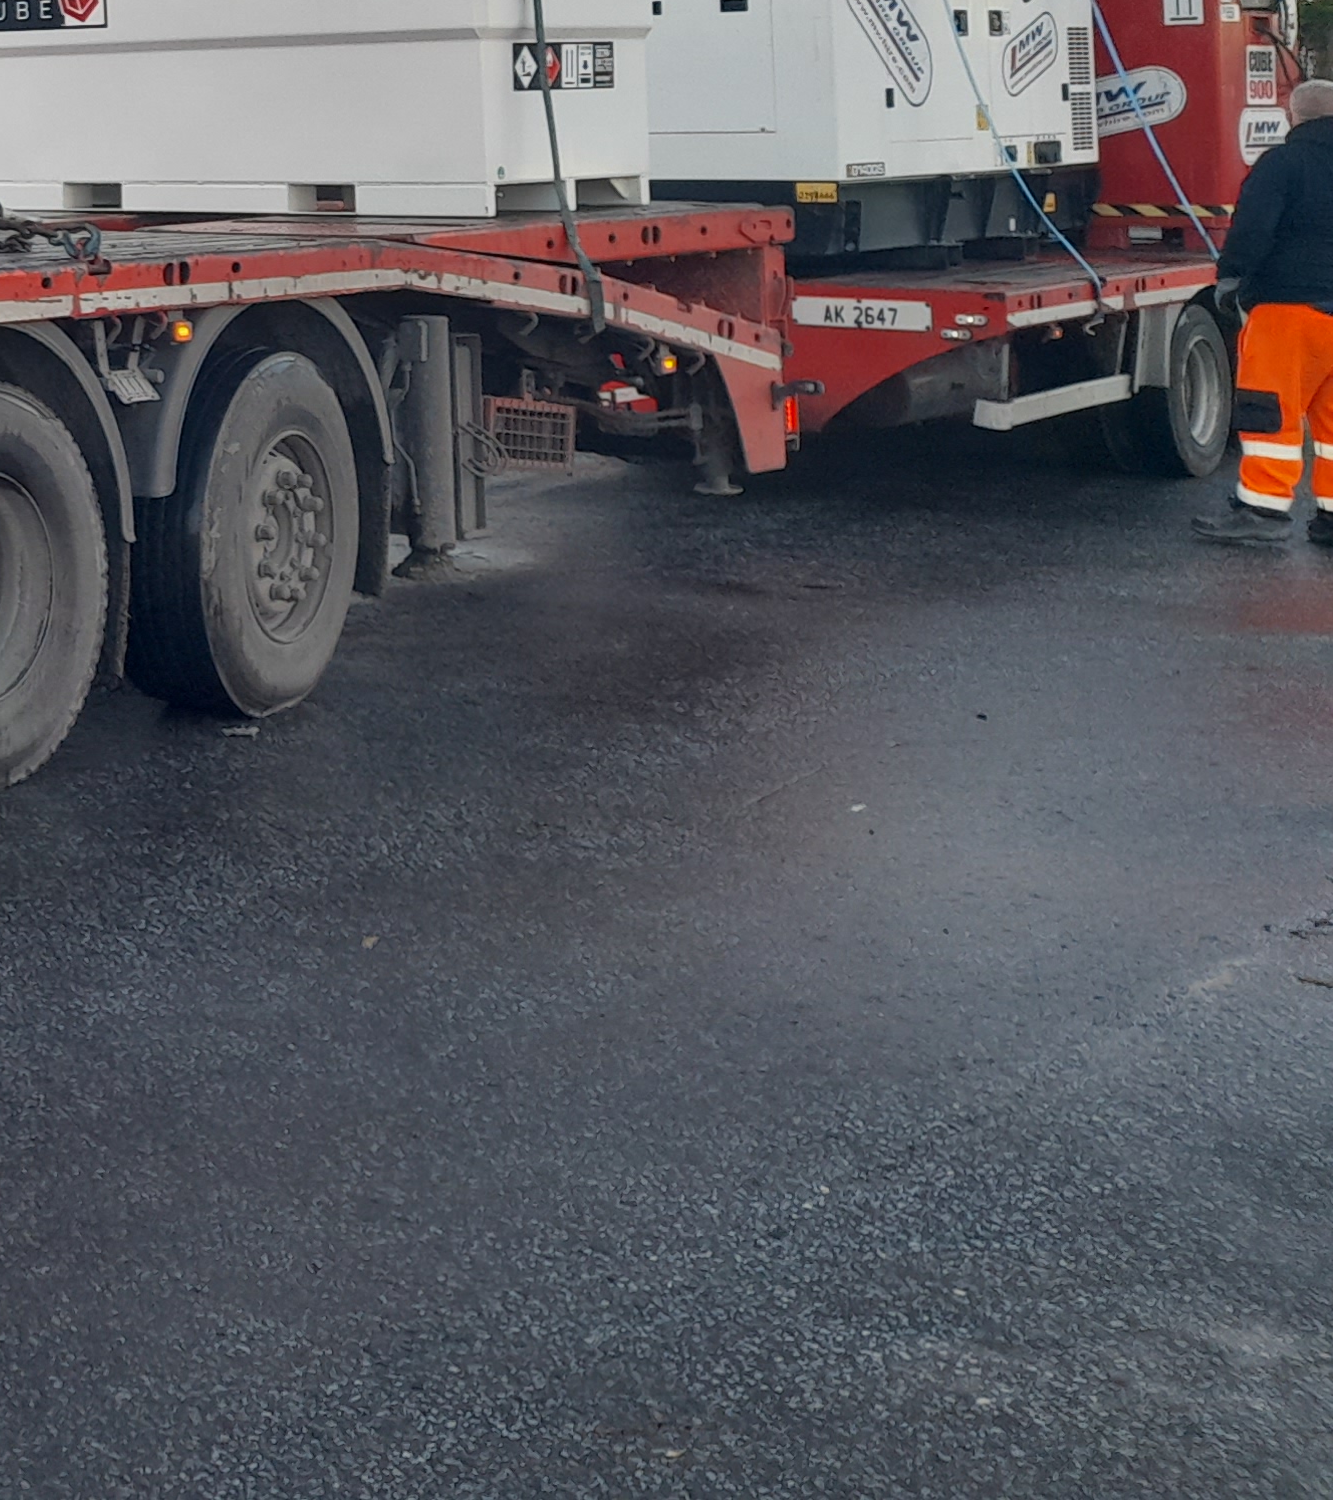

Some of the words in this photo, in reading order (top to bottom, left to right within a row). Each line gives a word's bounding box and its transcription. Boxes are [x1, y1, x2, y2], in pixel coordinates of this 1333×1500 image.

[1249, 79, 1274, 100] 900
[1254, 120, 1281, 134] MW
[823, 304, 846, 323] AK
[853, 305, 899, 327] 2647
